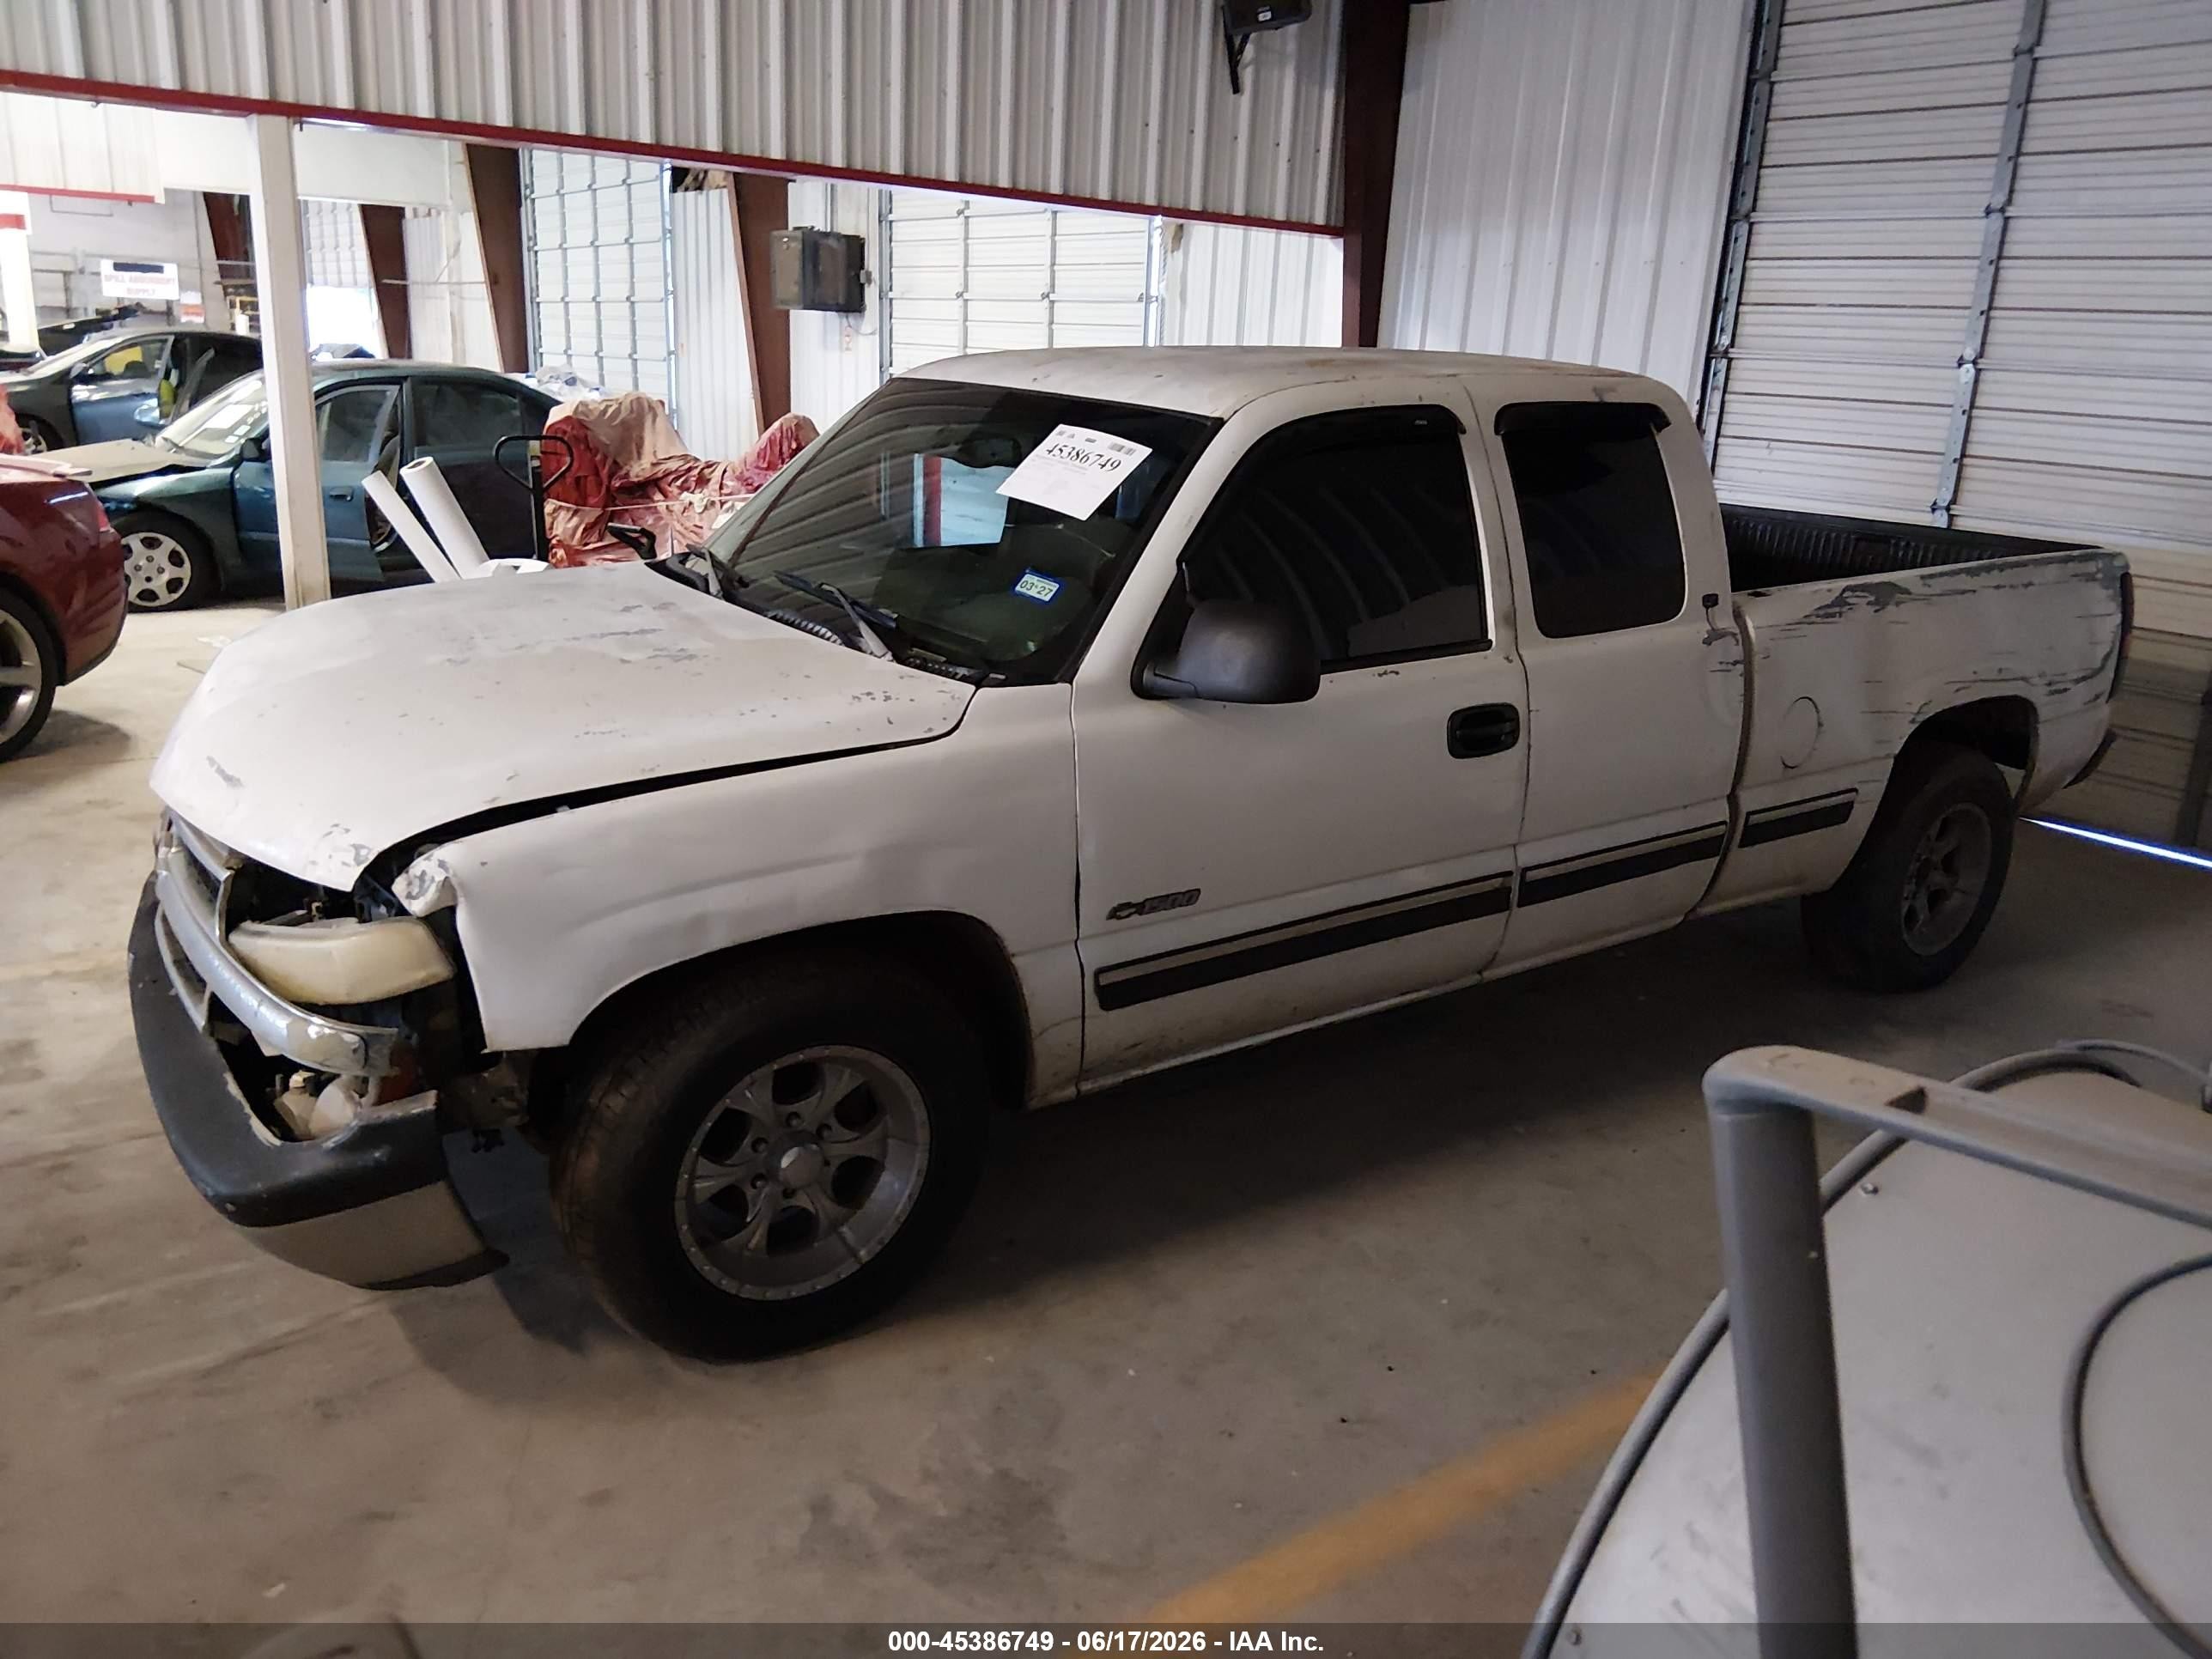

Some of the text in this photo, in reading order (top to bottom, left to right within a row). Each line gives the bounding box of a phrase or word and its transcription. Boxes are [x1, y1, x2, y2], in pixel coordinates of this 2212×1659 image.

[1046, 442, 1121, 472] 45386749
[1019, 580, 1035, 592] 03
[1036, 585, 1054, 597] 27
